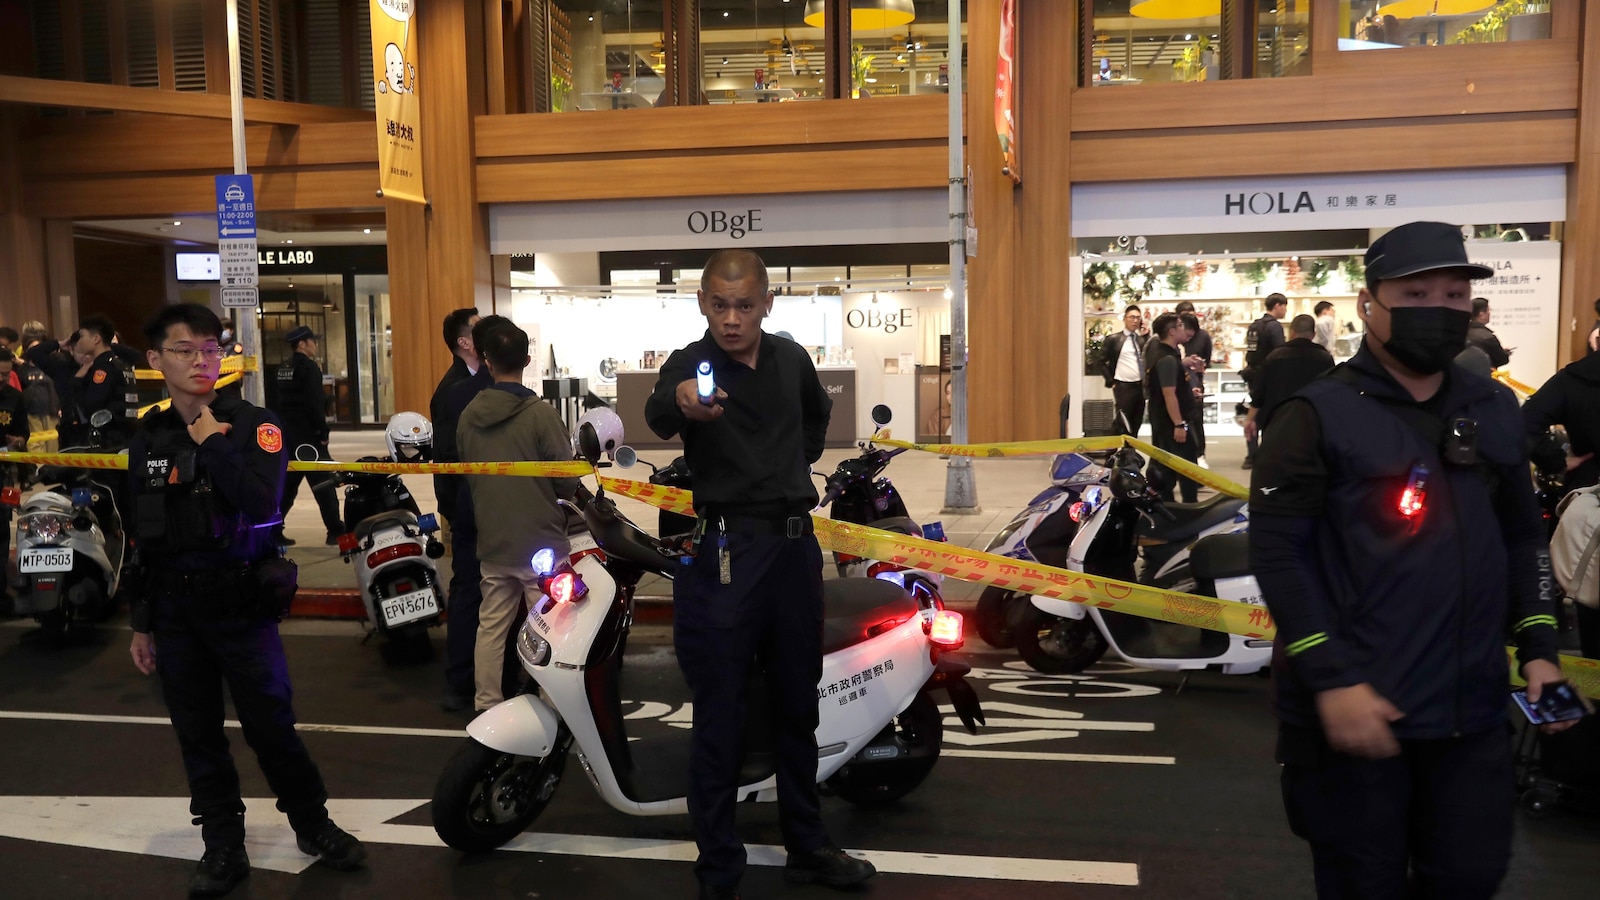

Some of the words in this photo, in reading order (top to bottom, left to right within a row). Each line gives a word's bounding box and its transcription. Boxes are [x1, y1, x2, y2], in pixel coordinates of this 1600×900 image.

[218, 202, 253, 212] 週一至週日
[1225, 191, 1315, 215] HOLA
[1326, 194, 1397, 208] 和樂家居
[219, 211, 254, 219] 11:00-22:00
[687, 209, 763, 240] OBgE
[258, 251, 275, 264] LE
[278, 250, 314, 265] LABO
[846, 308, 913, 334] OBgE
[827, 385, 844, 394] Self
[147, 458, 169, 468] POLICE
[22, 554, 71, 567] MTP-0503
[385, 595, 434, 620] EPV-5676
